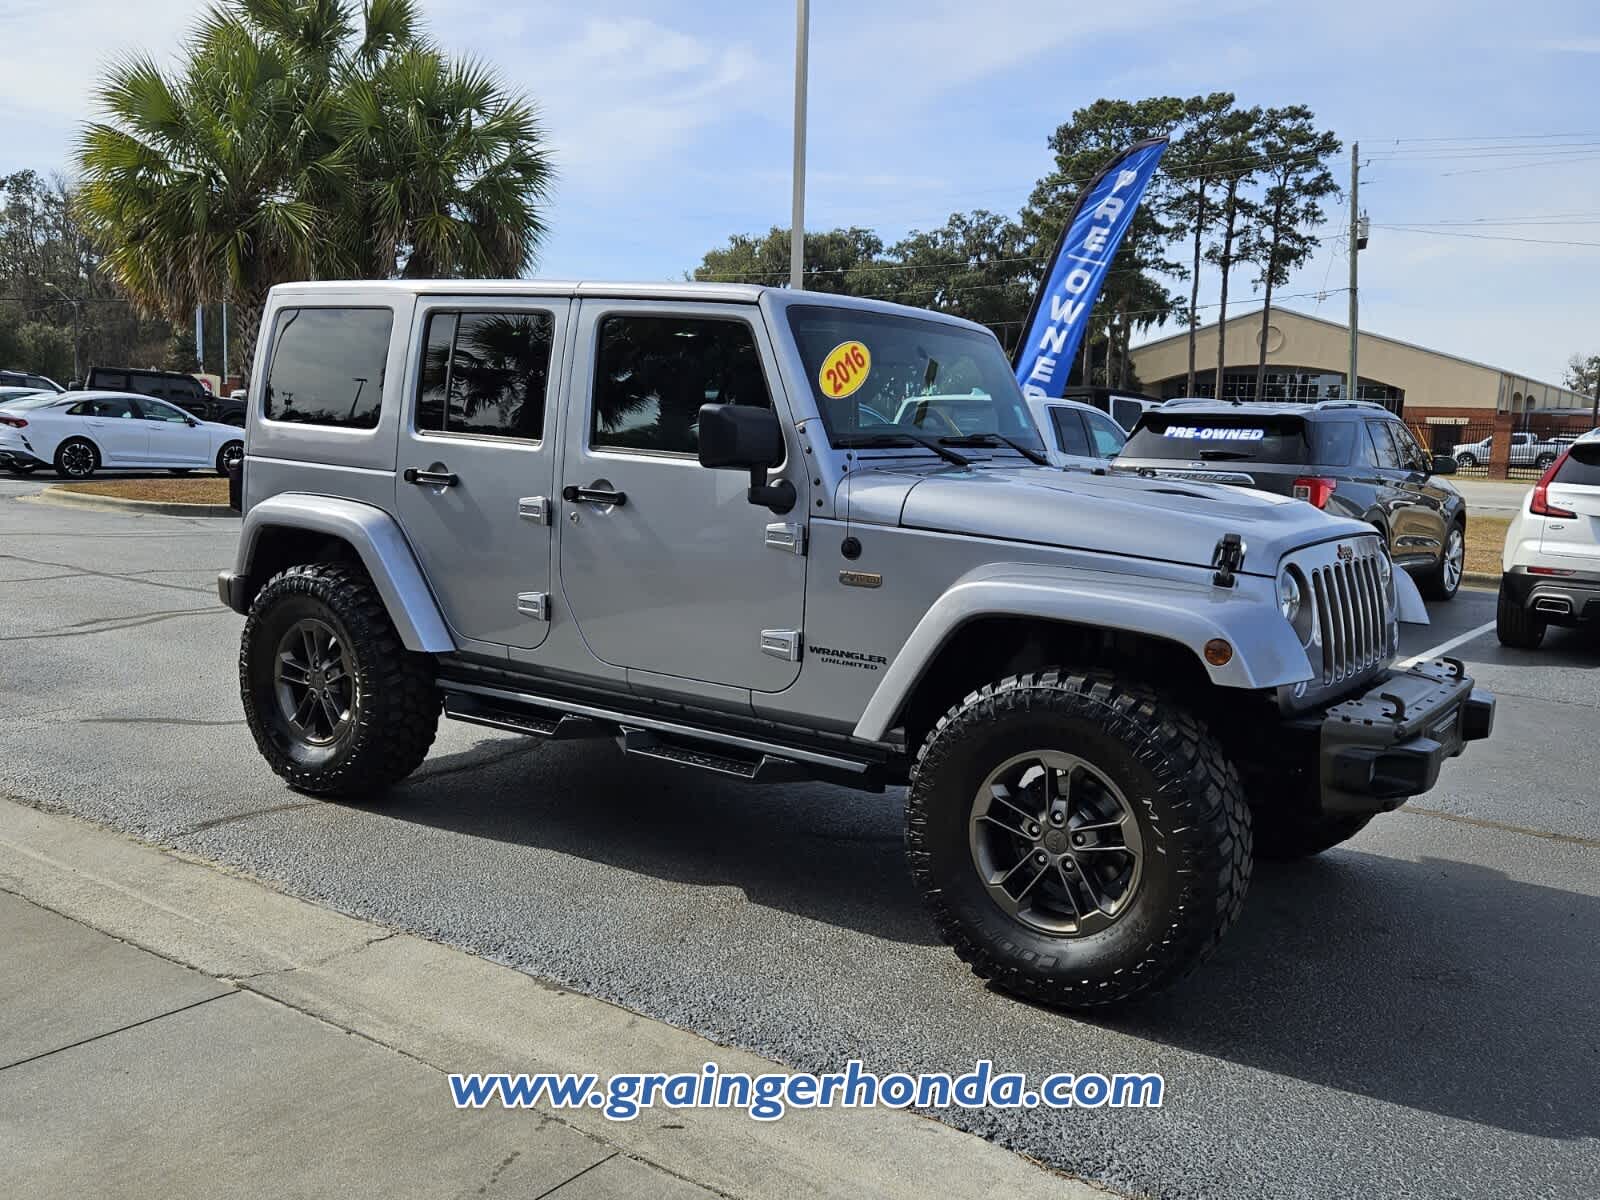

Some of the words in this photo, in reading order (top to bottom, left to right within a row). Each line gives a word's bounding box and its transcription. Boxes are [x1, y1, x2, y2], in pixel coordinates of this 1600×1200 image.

[826, 345, 865, 395] 2016
[1163, 426, 1264, 441] PRE-OWNED
[809, 646, 887, 665] WRANGLER
[821, 658, 878, 671] UNLIMITED
